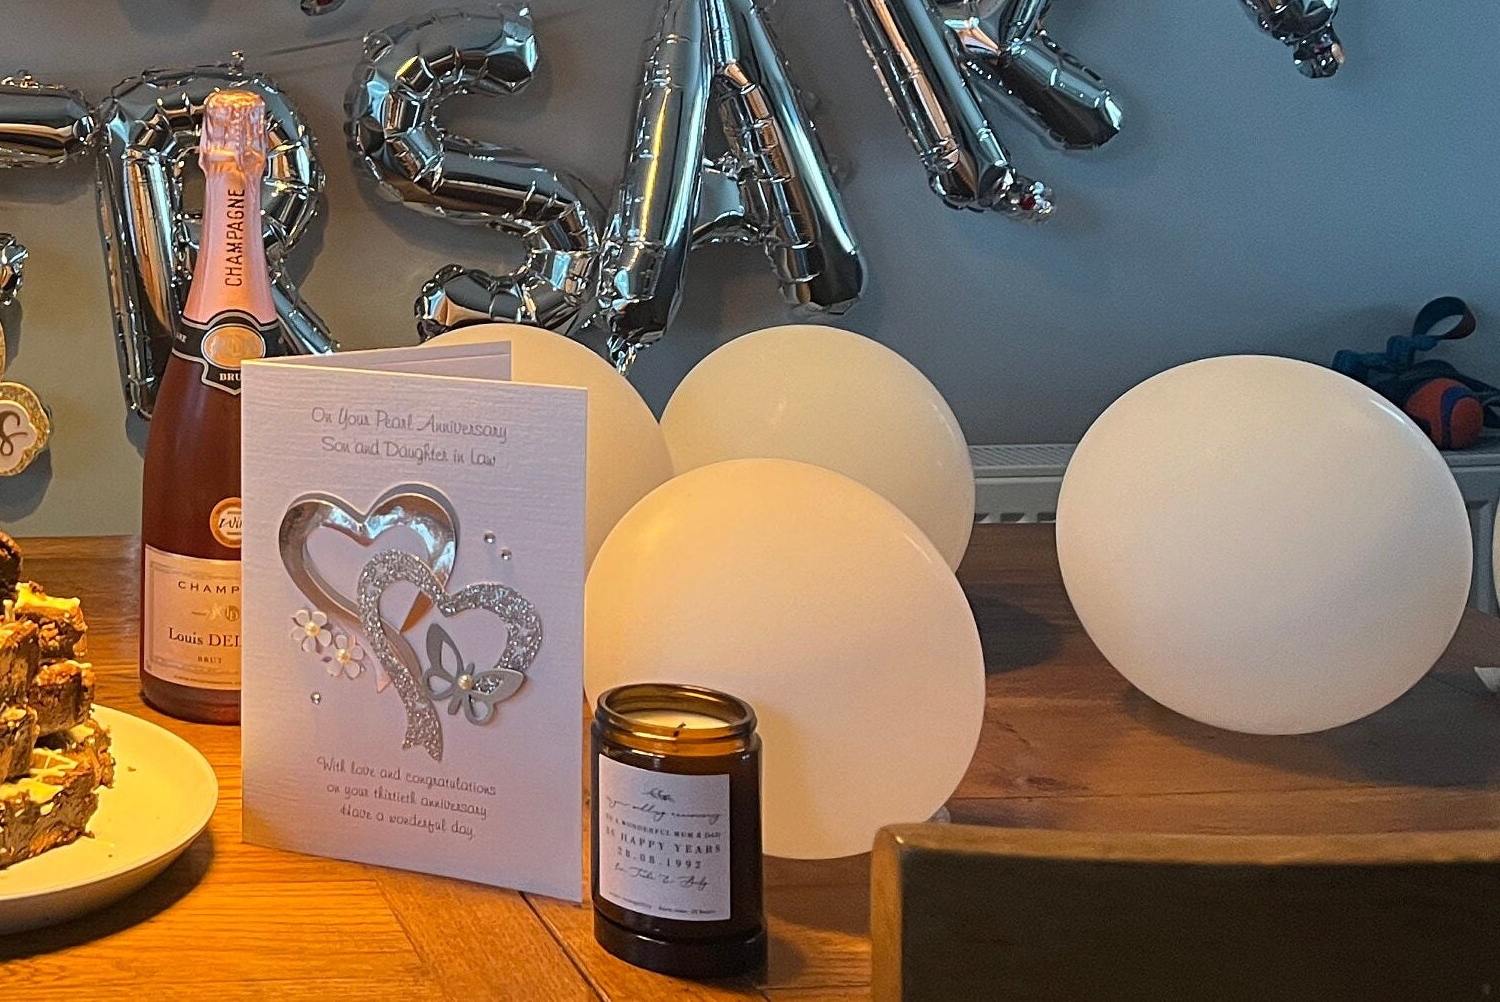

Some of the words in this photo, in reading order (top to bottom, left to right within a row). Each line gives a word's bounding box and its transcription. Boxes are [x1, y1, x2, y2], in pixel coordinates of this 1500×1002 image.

[225, 187, 246, 288] CHAMPAGNE
[219, 372, 242, 381] BRU
[311, 406, 332, 423] On
[338, 407, 370, 431] Your
[375, 409, 413, 431] Pearl
[417, 414, 507, 444] Anniversary
[321, 436, 351, 452] Son
[354, 440, 380, 456] and
[384, 440, 448, 465] Daughter
[453, 449, 464, 464] in
[470, 449, 496, 466] Law
[177, 580, 241, 595] CHAMP
[167, 626, 204, 647] Louis
[208, 632, 242, 648] DEL
[197, 654, 223, 665] BRUT
[317, 756, 346, 774] With
[351, 759, 375, 778] love
[380, 767, 401, 781] and
[405, 772, 497, 797] congratulations
[326, 783, 340, 794] on
[344, 785, 368, 799] your
[373, 786, 416, 804] thirtieth
[420, 797, 488, 821] anniversary
[340, 803, 372, 820] Have
[376, 811, 384, 822] a
[389, 813, 446, 834] wonderful
[620, 831, 664, 851] HAPPY
[674, 843, 721, 854] YEARS
